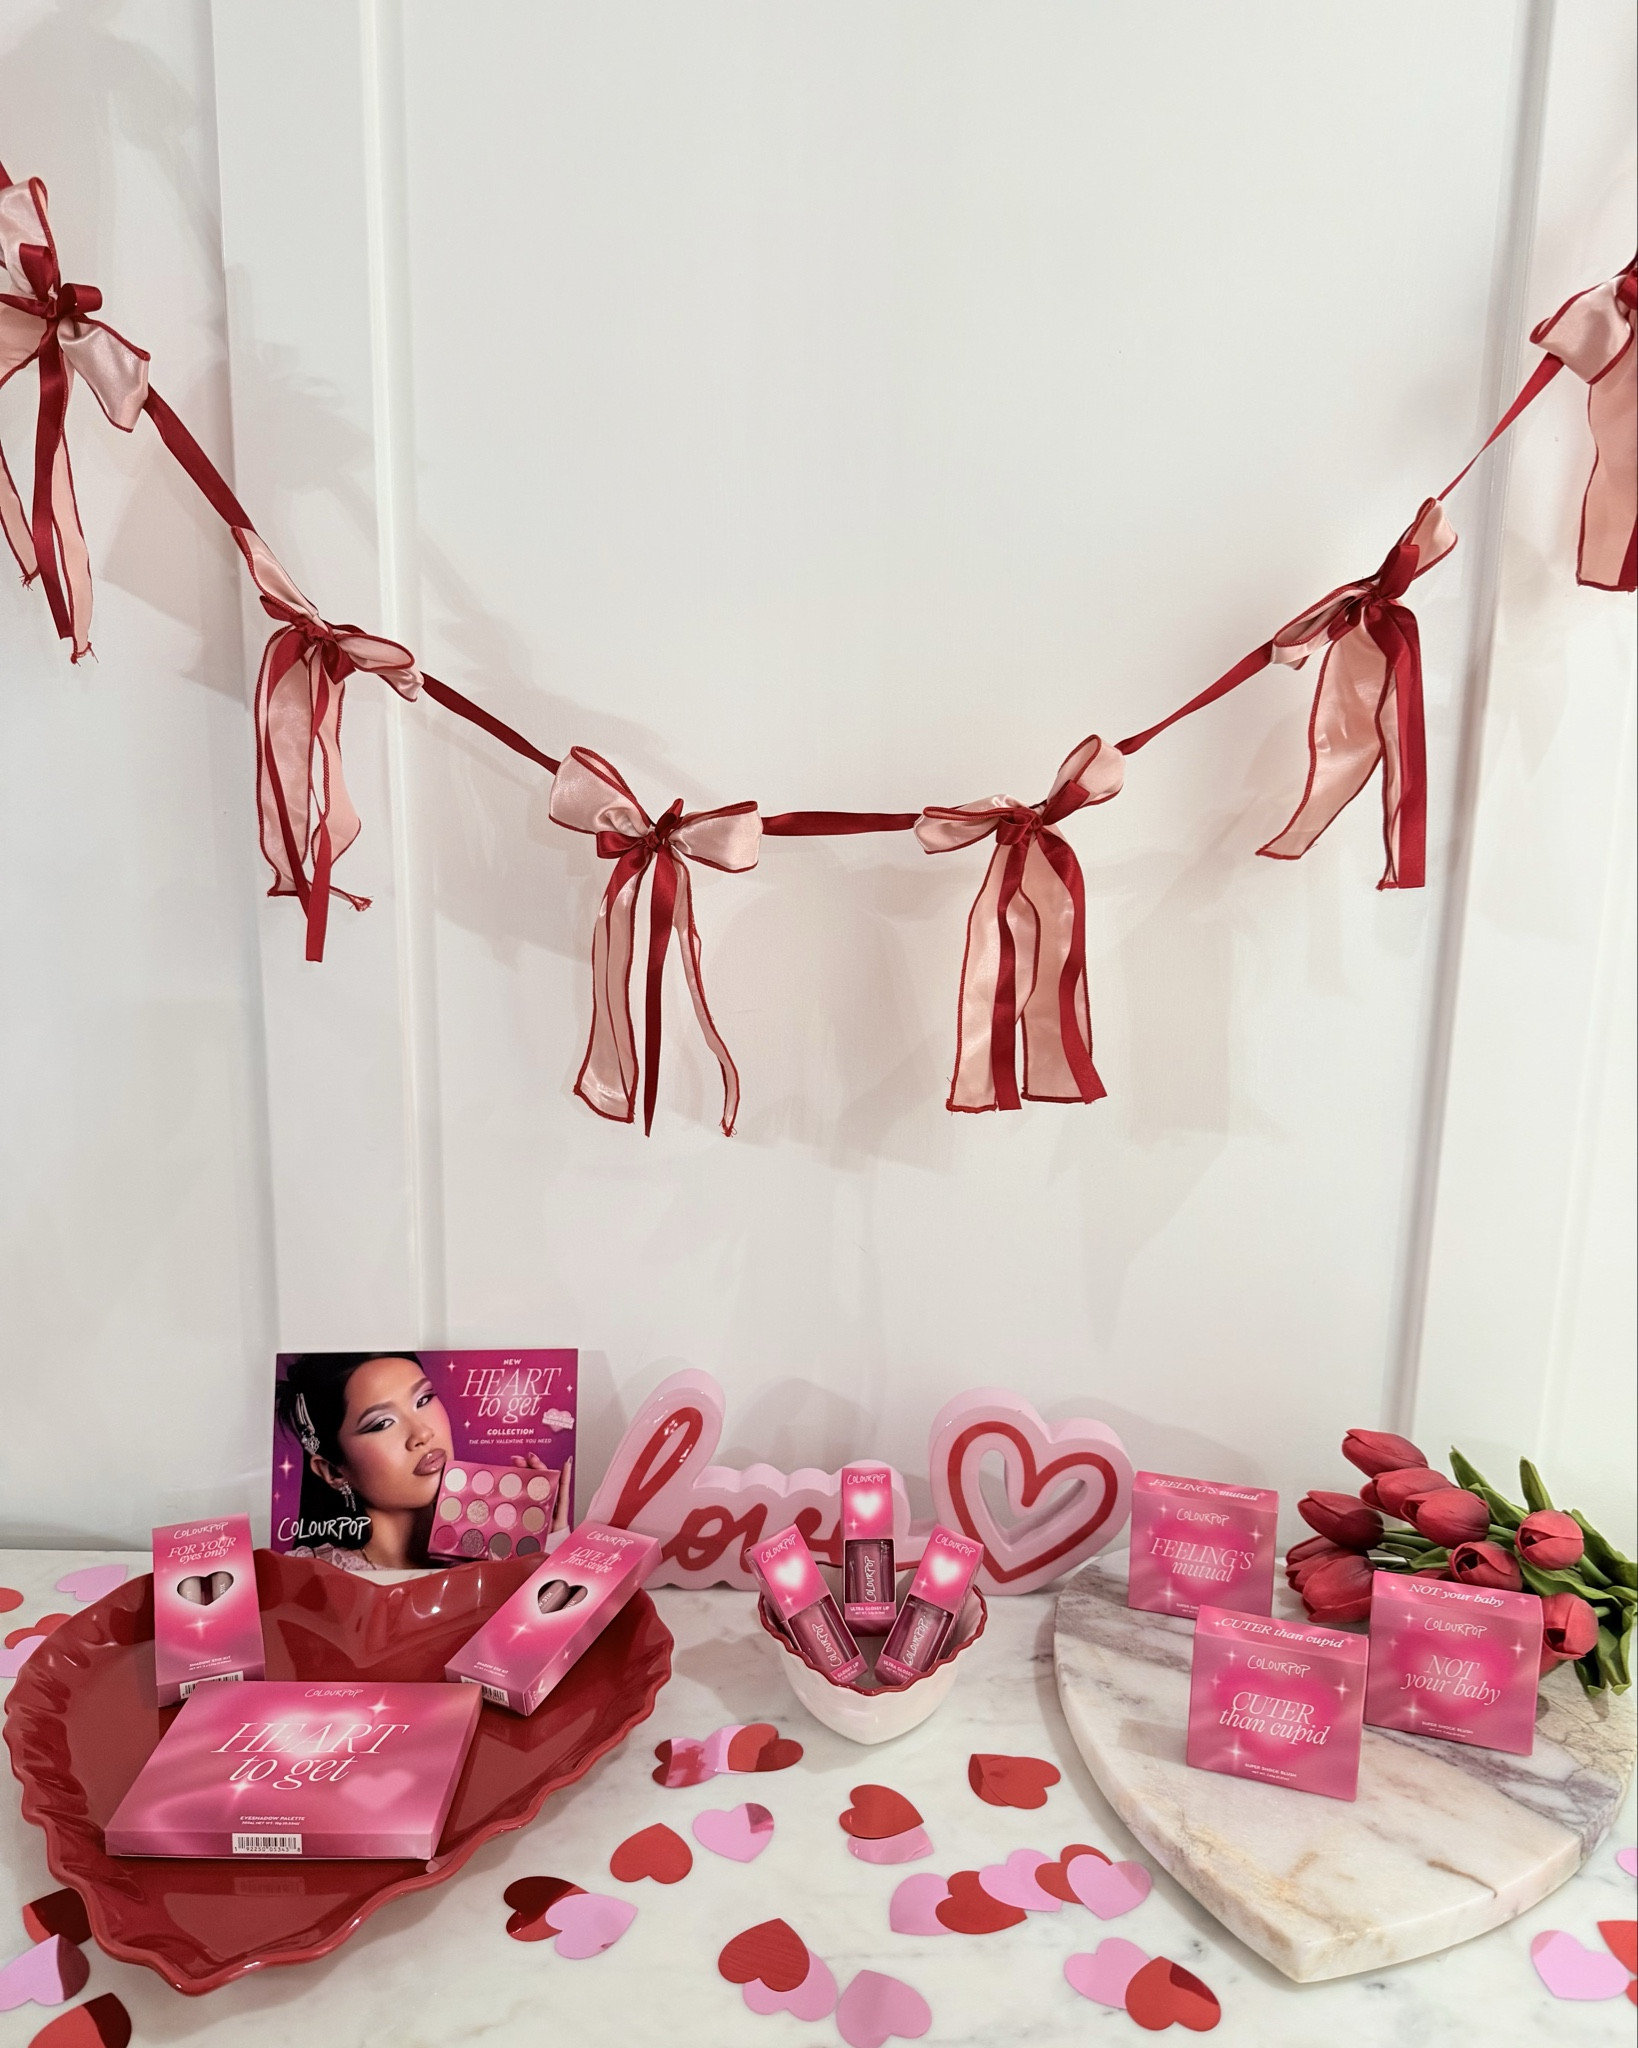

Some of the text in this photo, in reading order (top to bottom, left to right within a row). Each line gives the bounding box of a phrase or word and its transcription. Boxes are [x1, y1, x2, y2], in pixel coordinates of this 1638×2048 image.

[460, 1367, 562, 1397] HEART
[477, 1394, 501, 1417] to
[502, 1394, 542, 1423] get
[847, 1474, 887, 1485] COLOURPOP
[1151, 1478, 1260, 1501] FEELING'S mutual
[277, 1516, 372, 1542] COLOURPOP
[1176, 1508, 1230, 1526] COLOURPOP
[174, 1521, 229, 1539] COLOURPOP
[586, 1530, 634, 1548] COLOURPOP
[168, 1537, 237, 1558] FOR YOUR
[179, 1546, 229, 1565] eyes only
[570, 1547, 622, 1565] LOVE AT
[761, 1533, 796, 1563] COLOURPOP
[934, 1533, 976, 1557] COLOURPOP
[1150, 1537, 1255, 1570] FEELING'S
[561, 1554, 586, 1566] first
[1172, 1562, 1235, 1583] mutual
[864, 1555, 875, 1602] COLOURPOP
[1408, 1583, 1505, 1608] NOT your baby
[1220, 1617, 1345, 1649] CUTER than cupid
[1424, 1617, 1488, 1638] COLOURPOP
[812, 1623, 842, 1667] COLOURPOP
[902, 1619, 930, 1666] COLOURPOP
[1247, 1655, 1311, 1678] COLOURPOP
[1425, 1654, 1481, 1681] NOT
[304, 1688, 364, 1698] COLOURPOP
[1400, 1672, 1501, 1706] your baby
[1232, 1691, 1315, 1725] CUTER
[211, 1722, 411, 1754] HEART
[1219, 1709, 1331, 1746] than cupid
[228, 1755, 359, 1790] to get
